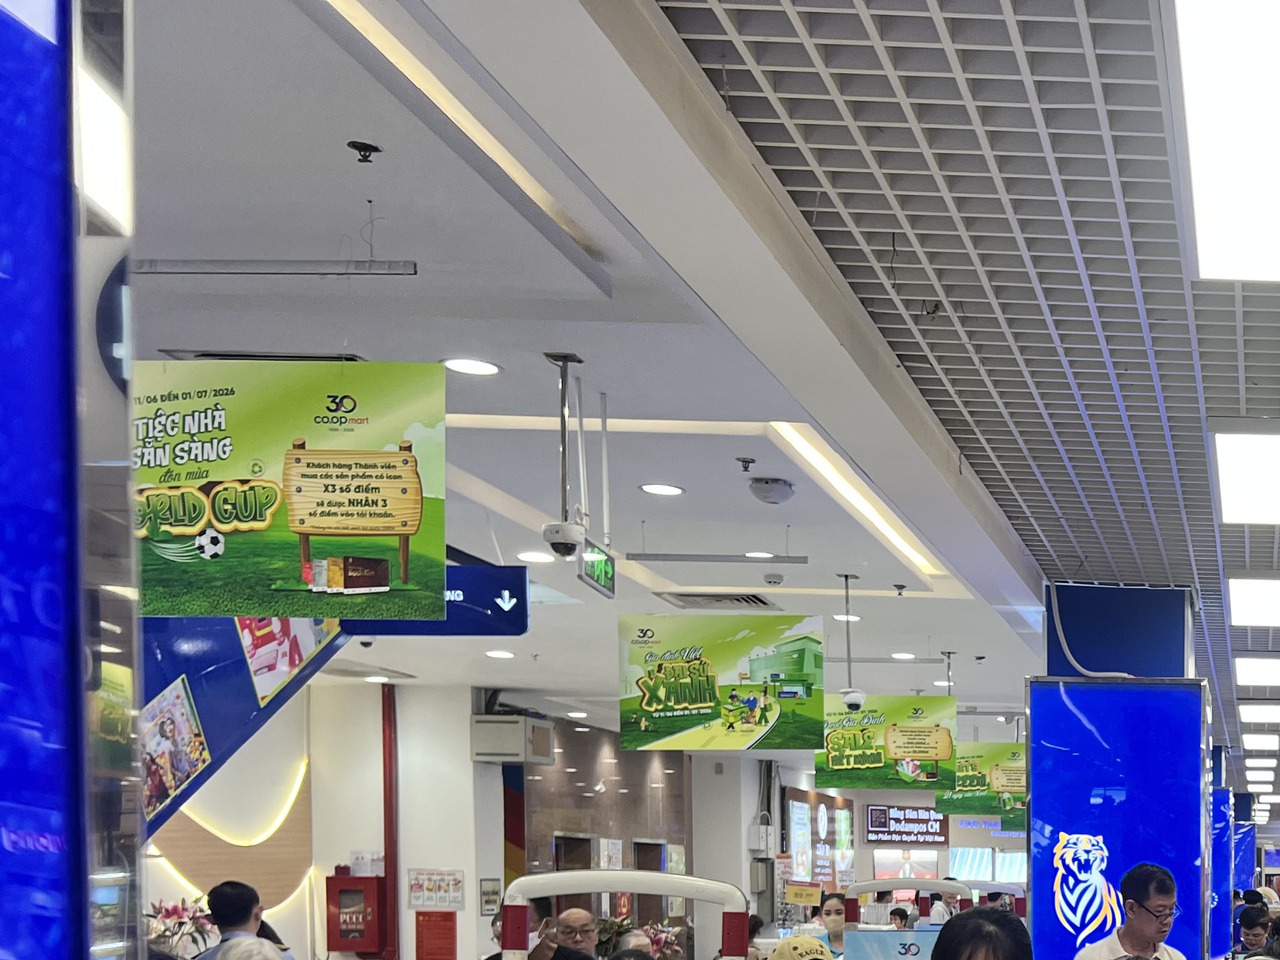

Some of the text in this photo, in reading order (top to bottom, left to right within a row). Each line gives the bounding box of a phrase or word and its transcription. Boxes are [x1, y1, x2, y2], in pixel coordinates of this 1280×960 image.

[160, 390, 180, 403] ĐẾN
[181, 387, 236, 401] 01/07/2026
[325, 394, 358, 414] 30
[133, 402, 227, 442] TIỆC NHÀ
[173, 436, 234, 466] SÀNG
[306, 461, 398, 471] Khách hàng Thành viên
[158, 467, 210, 484] đón mùa
[319, 471, 334, 480] các
[385, 472, 403, 480] icon
[323, 484, 337, 494] X3
[338, 483, 352, 494] số
[134, 485, 278, 530] ORLD CUP
[347, 496, 379, 508] NHÂN
[381, 498, 388, 508] 3
[637, 628, 655, 639] 30
[639, 673, 718, 708] XANH
[829, 730, 876, 752] SALE
[927, 821, 940, 833] CM
[799, 947, 826, 958] EAGLE
[897, 942, 921, 956] 30
